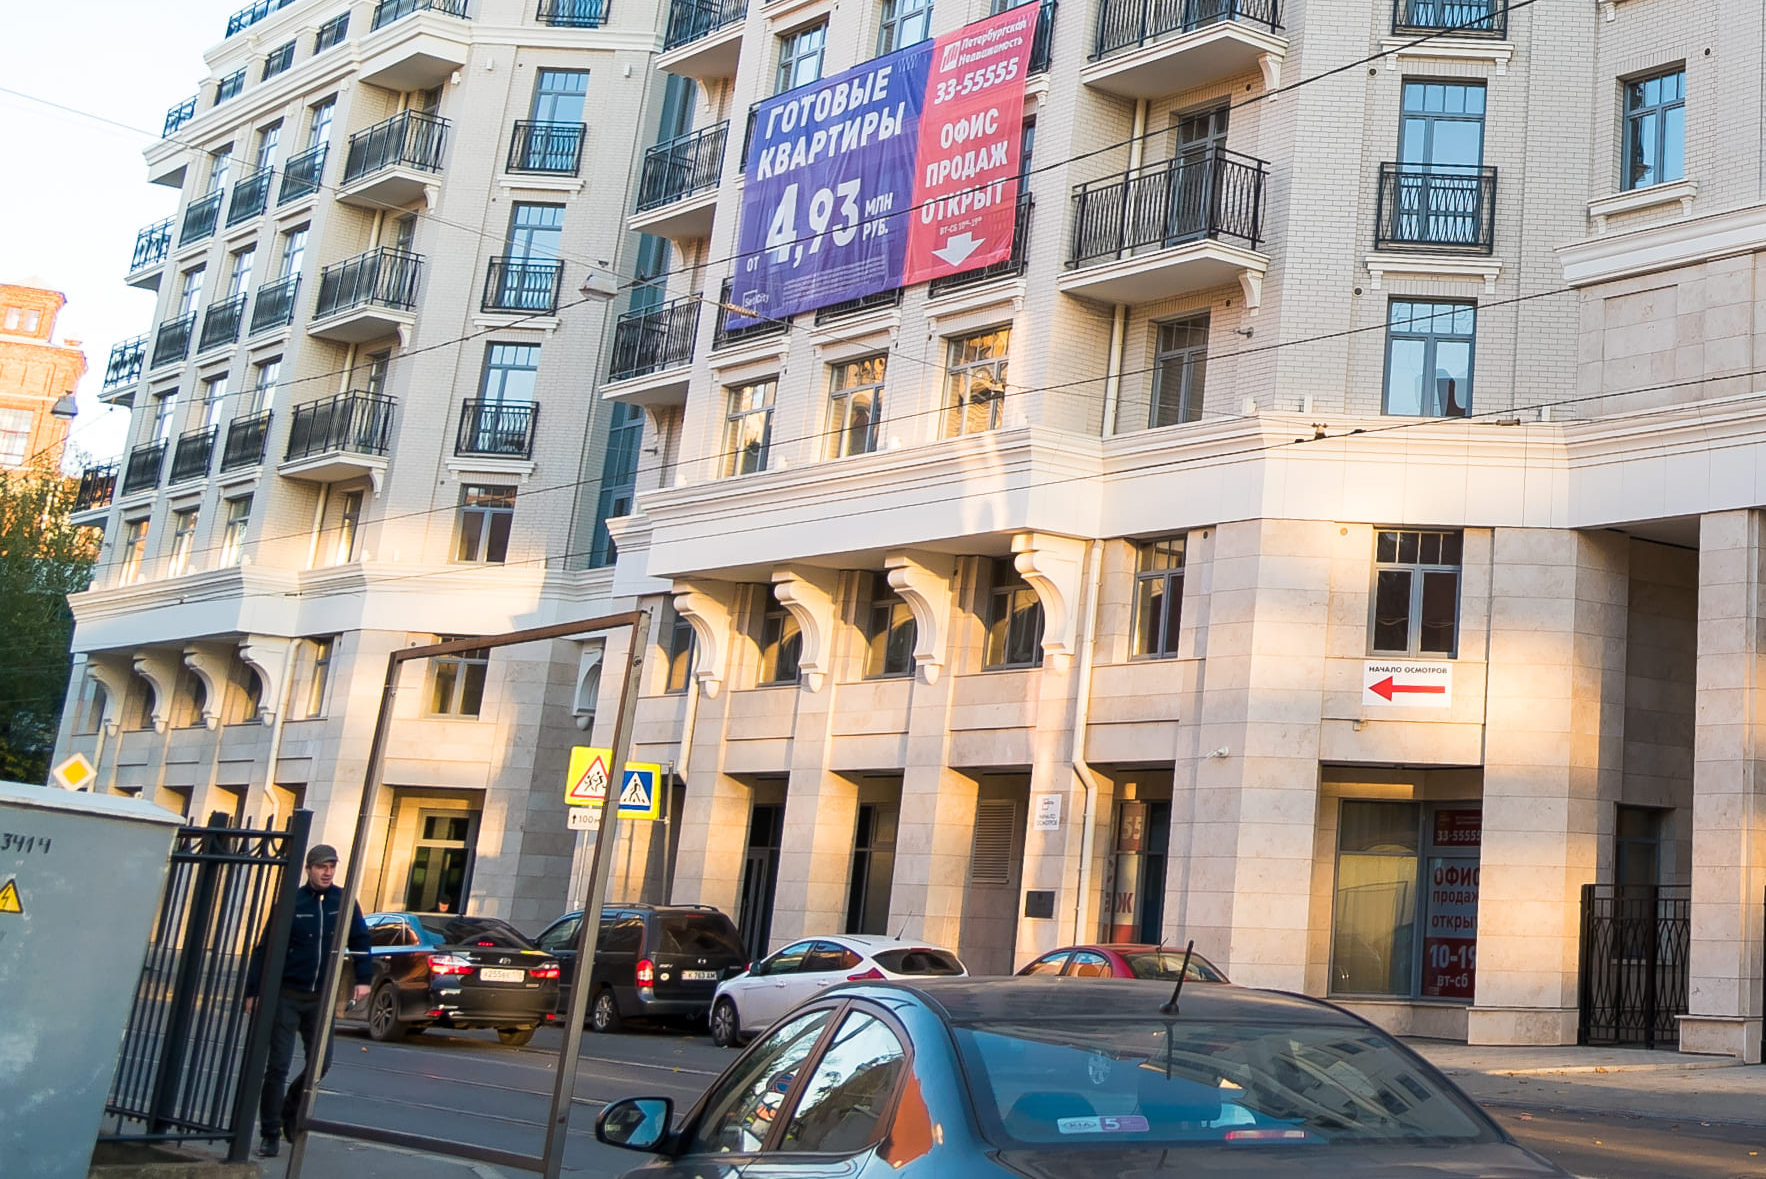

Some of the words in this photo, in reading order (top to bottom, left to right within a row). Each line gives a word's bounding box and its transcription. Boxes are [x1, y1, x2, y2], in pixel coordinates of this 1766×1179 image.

[765, 66, 893, 140] ГОТОВЫЕ
[934, 57, 1019, 105] 33-55555
[757, 102, 906, 182] КВАРТИРЫ
[940, 108, 999, 149] ОФИС
[925, 140, 1008, 188] ПРОДАЖ
[765, 178, 861, 268] 4,93
[865, 192, 894, 217] МЛН
[921, 177, 1007, 224] ОТКРЫТ
[1369, 666, 1402, 674] НАЧАЛО
[1404, 666, 1448, 674] ОСМОТРОВ
[579, 815, 593, 823] 100
